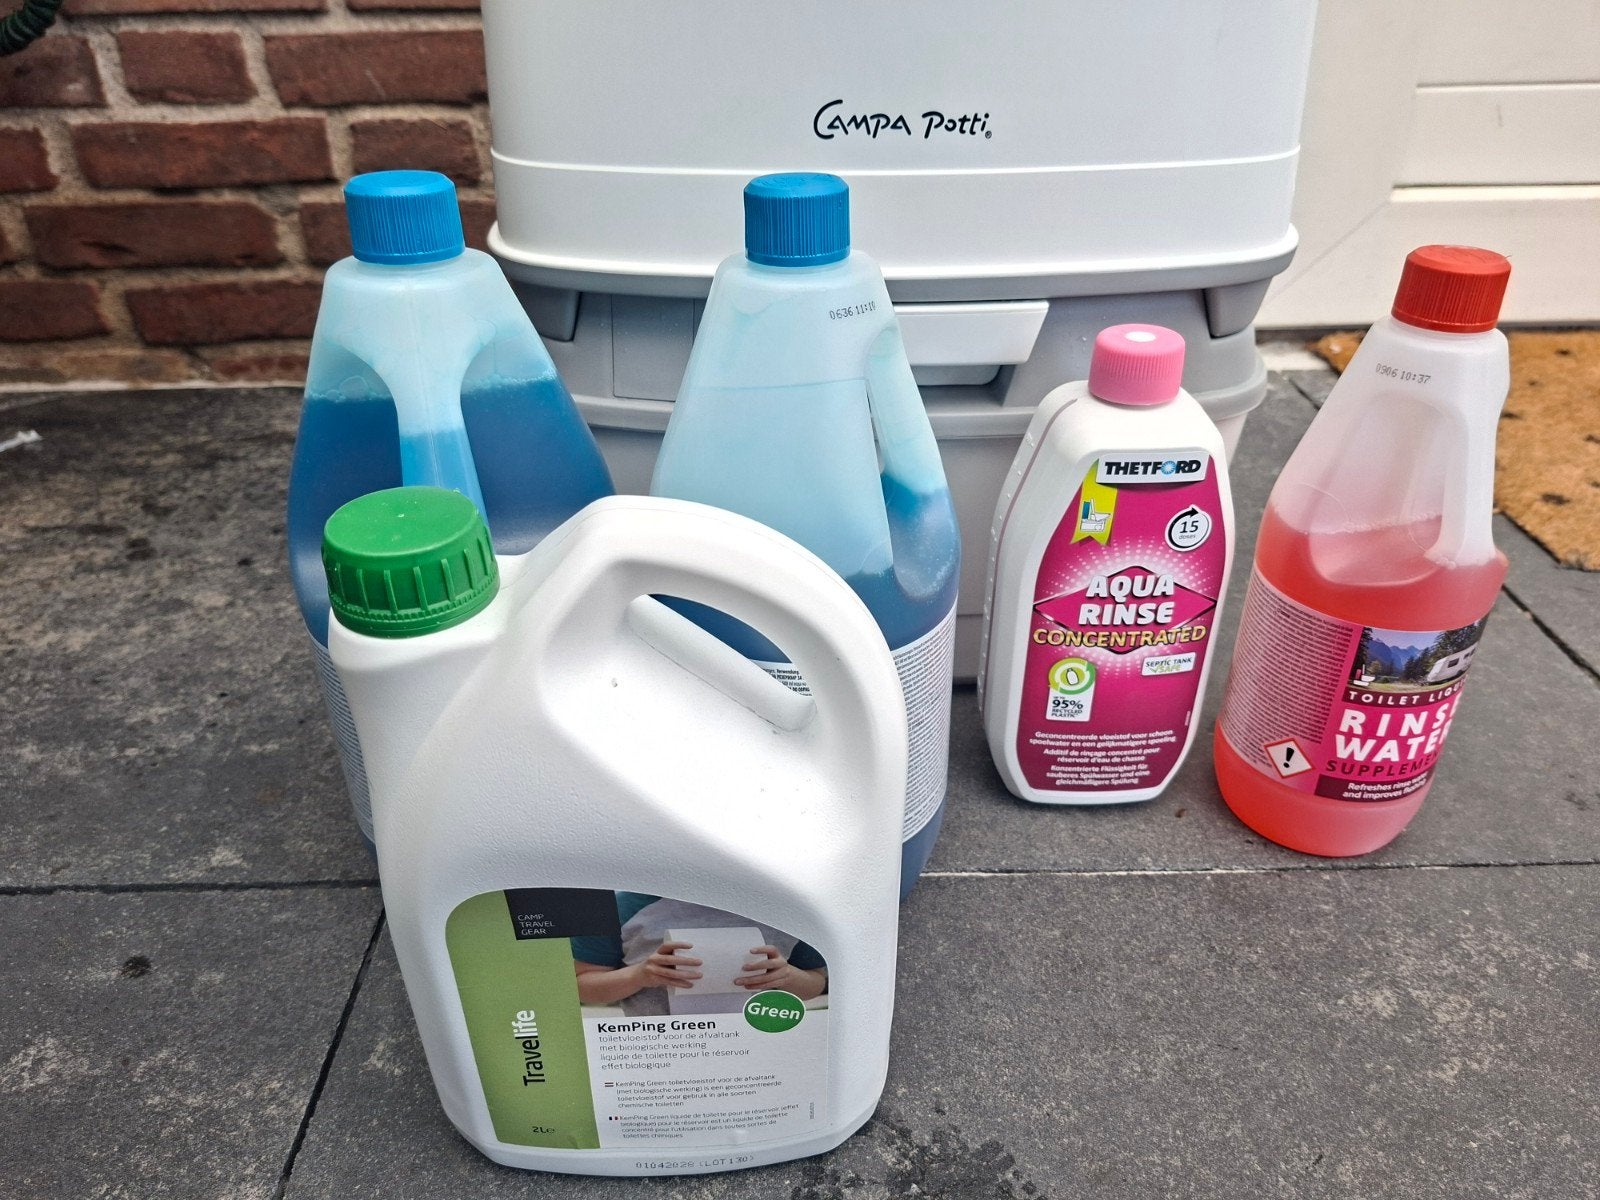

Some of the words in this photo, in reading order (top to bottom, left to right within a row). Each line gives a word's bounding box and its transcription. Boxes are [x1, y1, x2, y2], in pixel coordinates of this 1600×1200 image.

[1400, 370, 1431, 383] 10:37
[1104, 460, 1202, 475] THETFORD
[1180, 520, 1199, 533] 15
[1085, 574, 1175, 603] AQUA
[1078, 602, 1175, 626] RINSE
[1033, 625, 1207, 647] CONCENTRATED
[1348, 690, 1420, 706] TOILET
[1052, 700, 1083, 709] 95%
[1035, 731, 1098, 740] Geconcentreerde
[1099, 732, 1130, 740] vloeistof
[1148, 729, 1173, 738] schoon
[1029, 738, 1070, 747] spoelwater
[1148, 736, 1176, 745] spoeling
[1043, 748, 1069, 756] Additif
[1069, 748, 1078, 756] de
[1080, 748, 1107, 757] rinçage
[1107, 748, 1142, 756] concentré
[1143, 747, 1160, 755] pour
[1120, 770, 1134, 778] und
[1348, 782, 1392, 792] Refreshes
[1393, 780, 1411, 790] rinse
[1343, 790, 1361, 798] and
[1363, 789, 1402, 800] improves
[747, 1002, 800, 1020] Green
[597, 1021, 666, 1033] KemPing
[671, 1020, 716, 1031] Green
[599, 1033, 660, 1043] toiletvloeistof
[685, 1032, 697, 1040] de
[699, 1031, 741, 1039] afvaltank
[512, 1009, 545, 1086] Travellife
[619, 1042, 669, 1052] biologische
[671, 1041, 707, 1050] werking
[600, 1053, 630, 1062] liquide
[645, 1051, 677, 1059] toilette
[680, 1052, 700, 1060] pour
[712, 1049, 750, 1057] réservoir
[625, 1061, 671, 1070] biologique
[616, 1080, 645, 1088] KemPing
[669, 1077, 716, 1085] toiletvloeistof
[725, 1081, 782, 1090] geconcentreerde
[617, 1094, 664, 1102] toiletvloeistof
[683, 1092, 707, 1100] gebruik
